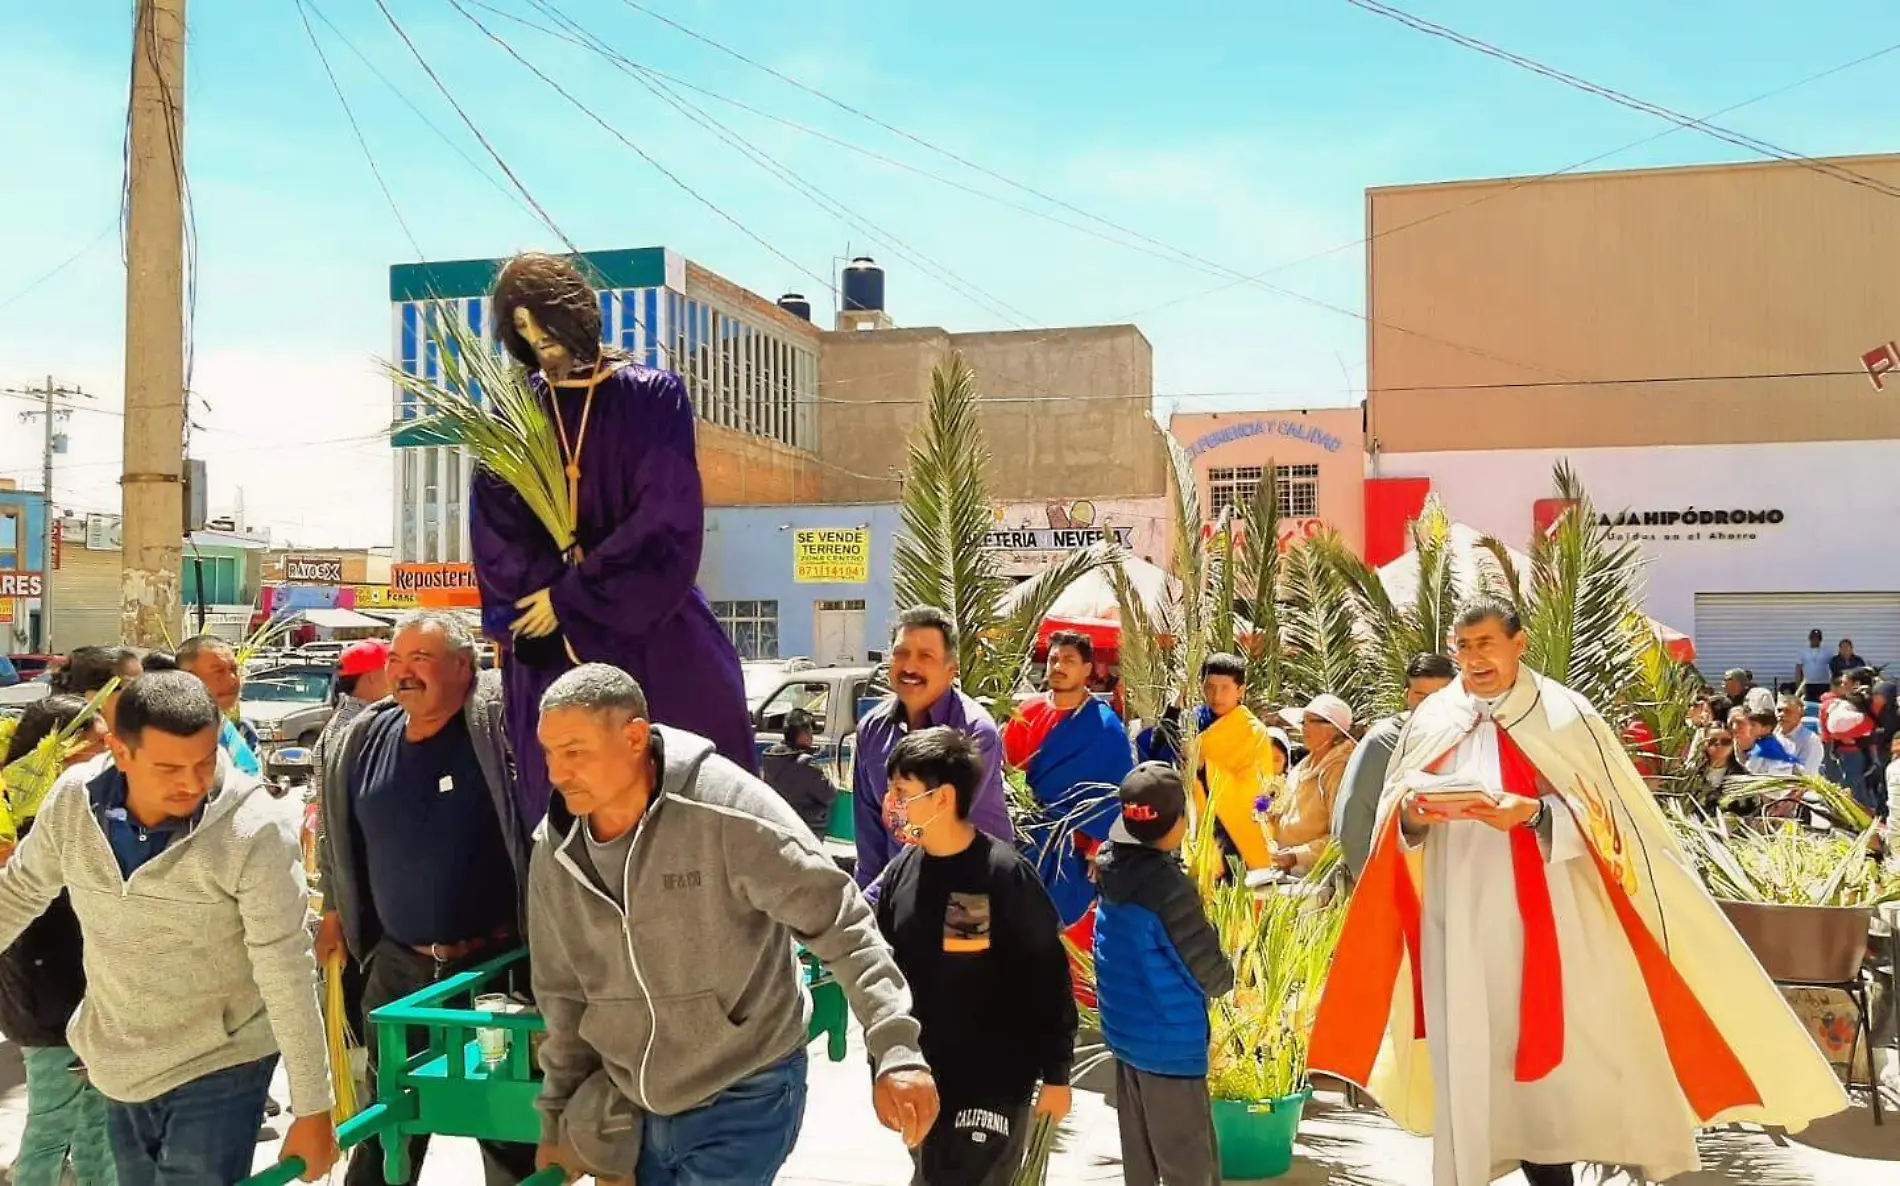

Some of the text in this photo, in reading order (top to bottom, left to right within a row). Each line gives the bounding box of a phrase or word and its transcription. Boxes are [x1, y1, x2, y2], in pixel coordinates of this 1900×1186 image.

[797, 532, 863, 543] SE VENDE
[801, 544, 860, 555] TERRENO
[0, 575, 42, 595] RES
[955, 1108, 1009, 1136] CALIFORNIA
